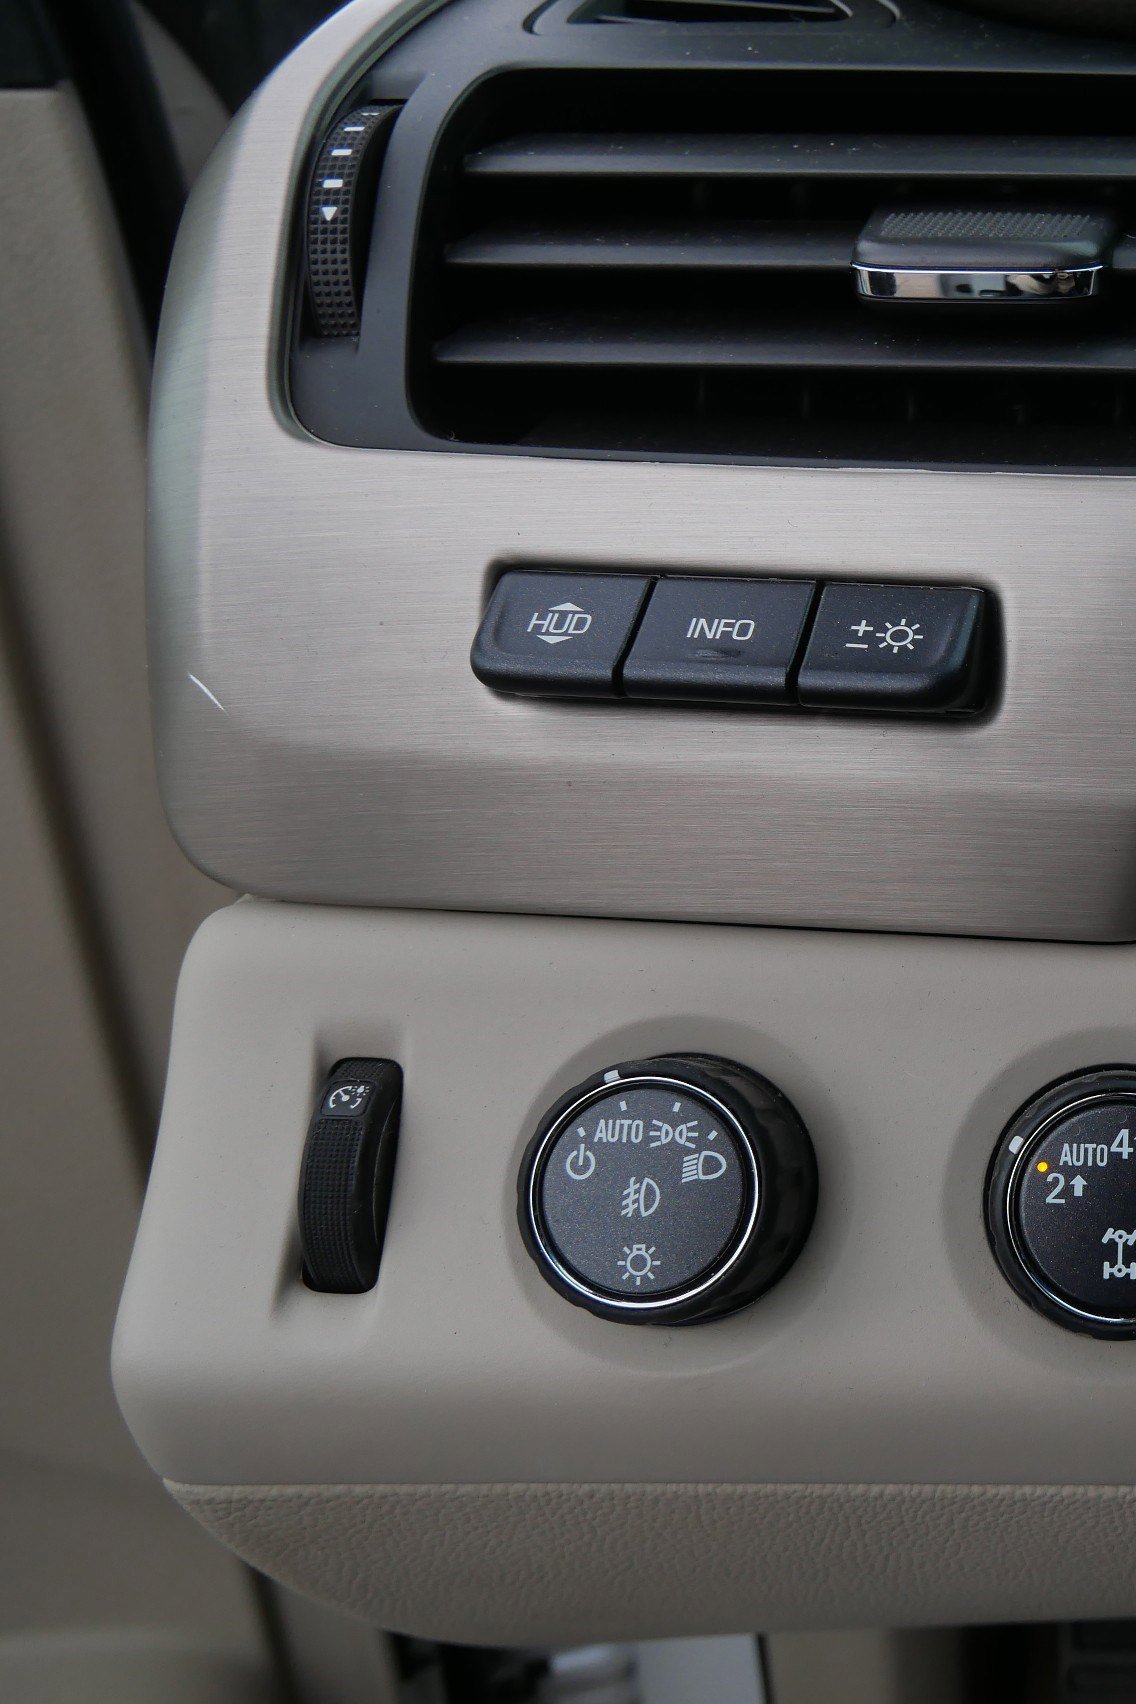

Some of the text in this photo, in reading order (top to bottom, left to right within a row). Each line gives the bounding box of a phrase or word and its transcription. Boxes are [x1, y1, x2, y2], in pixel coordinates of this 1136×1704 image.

[526, 611, 593, 635] HUD
[685, 617, 756, 642] INFO
[593, 1118, 645, 1144] AUTO
[1059, 1142, 1108, 1167] AUTO
[1110, 1128, 1134, 1160] 4
[1045, 1172, 1066, 1205] 2
